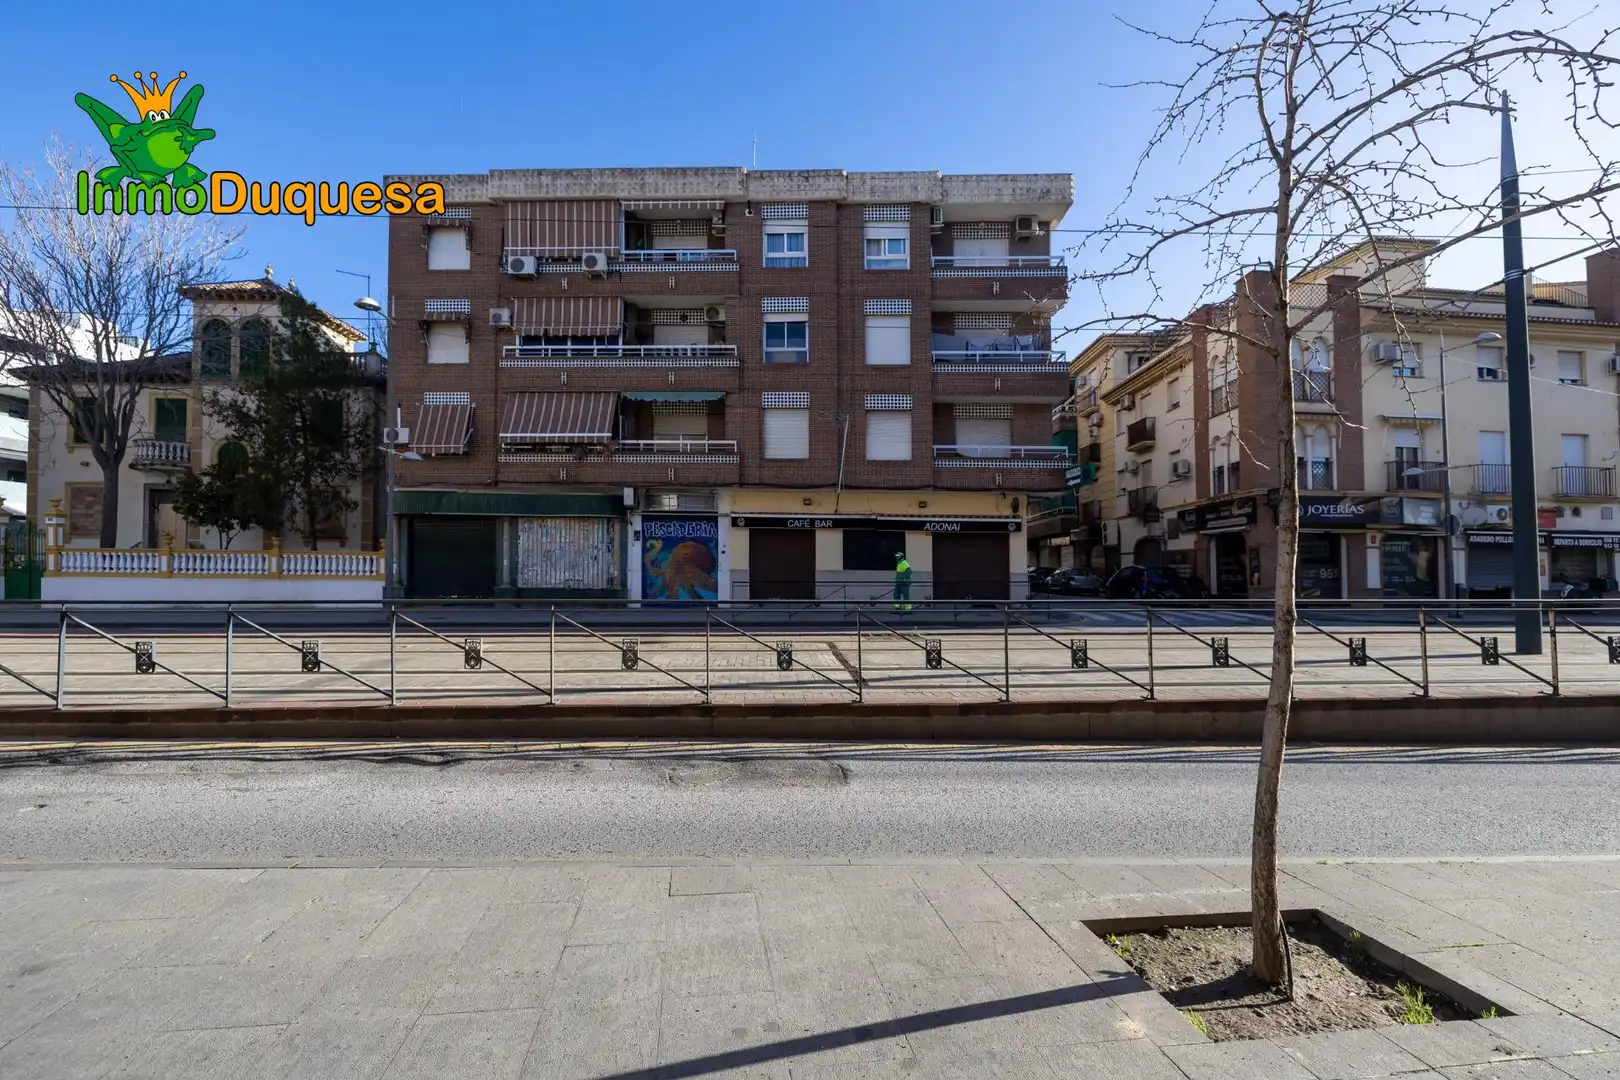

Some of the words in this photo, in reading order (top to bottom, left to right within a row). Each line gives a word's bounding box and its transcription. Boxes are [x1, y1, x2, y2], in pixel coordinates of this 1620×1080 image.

[787, 518, 811, 528] CAFÉ
[814, 519, 833, 528] BAR
[923, 522, 961, 532] ADONAI
